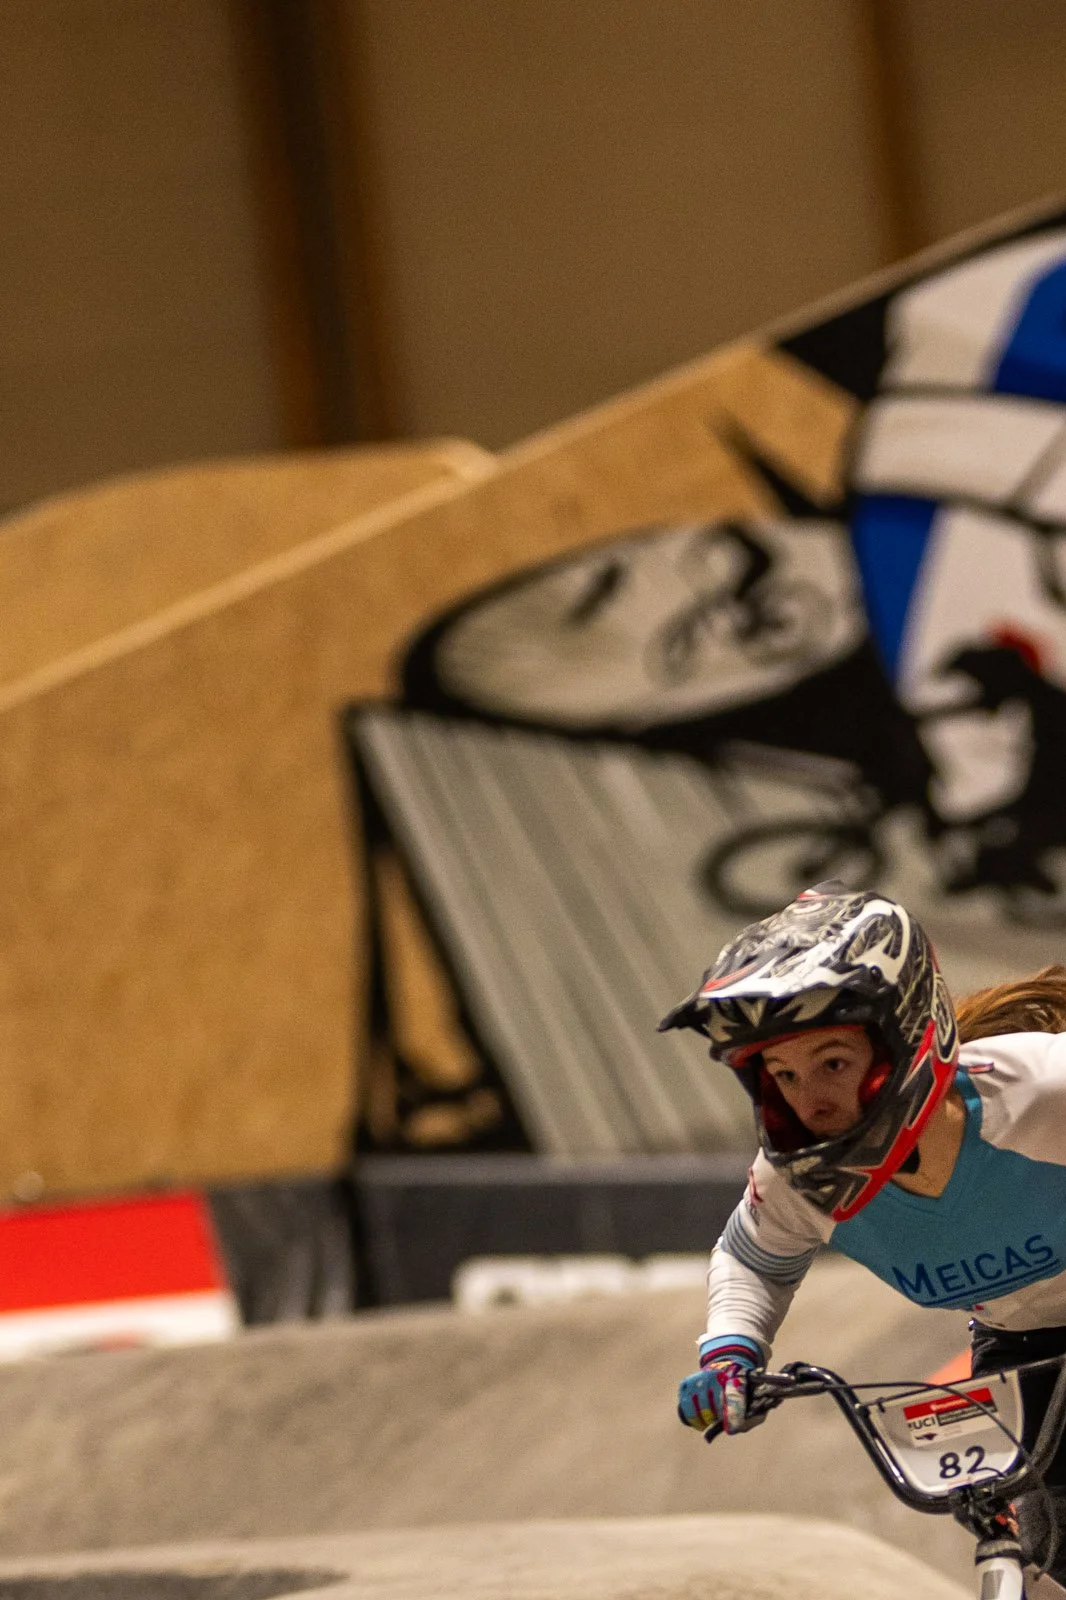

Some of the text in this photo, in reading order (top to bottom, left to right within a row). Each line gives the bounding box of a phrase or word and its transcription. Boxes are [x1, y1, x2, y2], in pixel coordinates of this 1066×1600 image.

[892, 1235, 1053, 1297] MEICAS
[913, 1417, 936, 1430] UCI
[939, 1445, 986, 1479] 82
